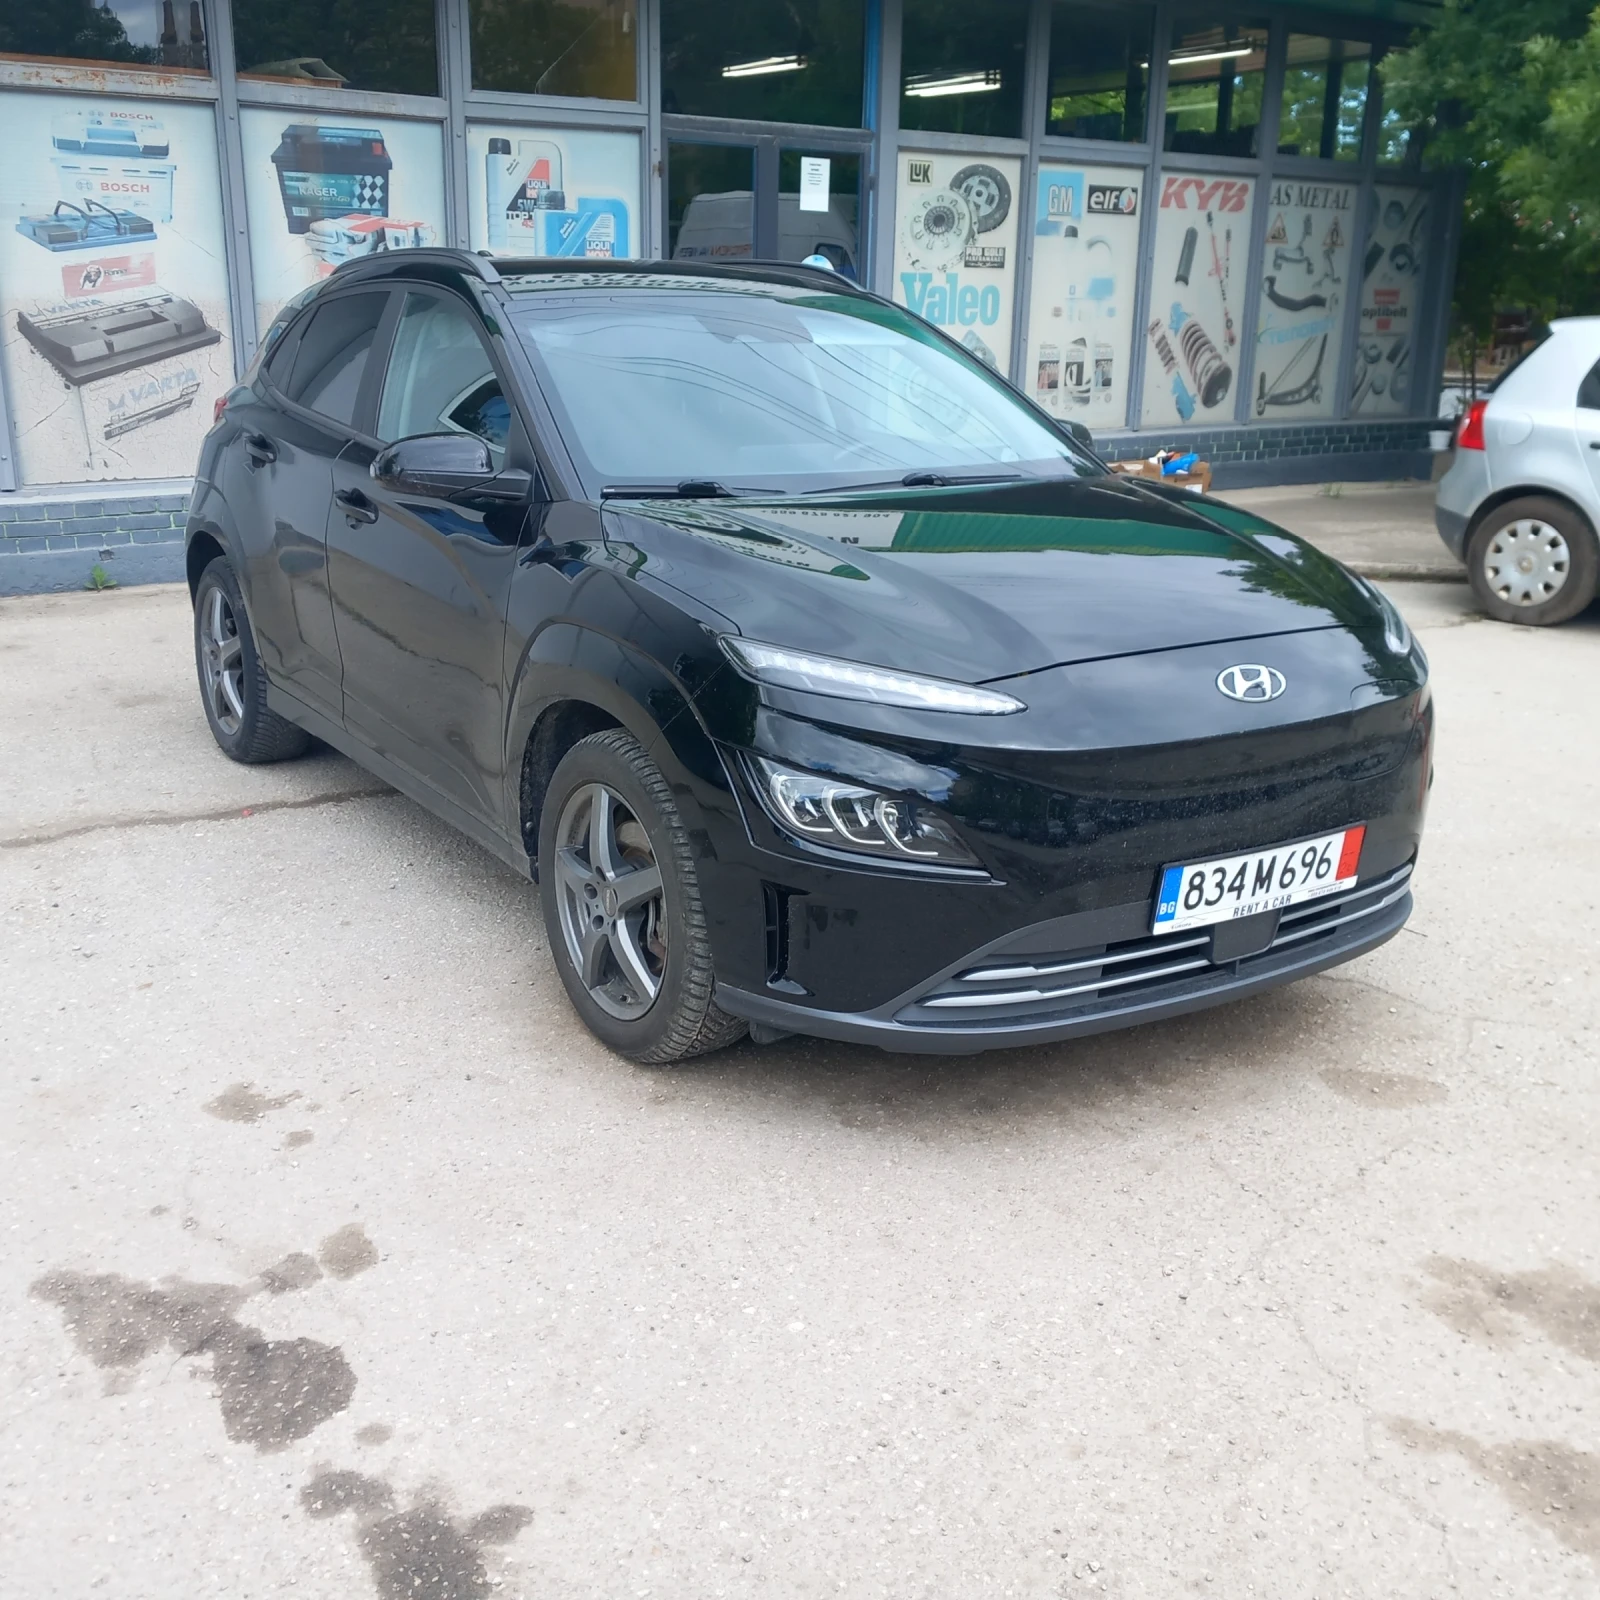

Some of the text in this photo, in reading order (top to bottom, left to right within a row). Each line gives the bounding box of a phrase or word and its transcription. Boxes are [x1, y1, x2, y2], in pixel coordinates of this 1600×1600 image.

[110, 111, 154, 121] BOSCH
[100, 182, 150, 193] BOSCH
[1048, 184, 1073, 213] GM
[1160, 176, 1250, 212] KYB
[1269, 184, 1351, 210] AS METAL
[1089, 189, 1120, 210] elf
[586, 241, 610, 250] LIQUI
[900, 272, 1000, 326] Valeo
[1159, 900, 1176, 915] BG
[1232, 894, 1292, 918] RENT A CAR
